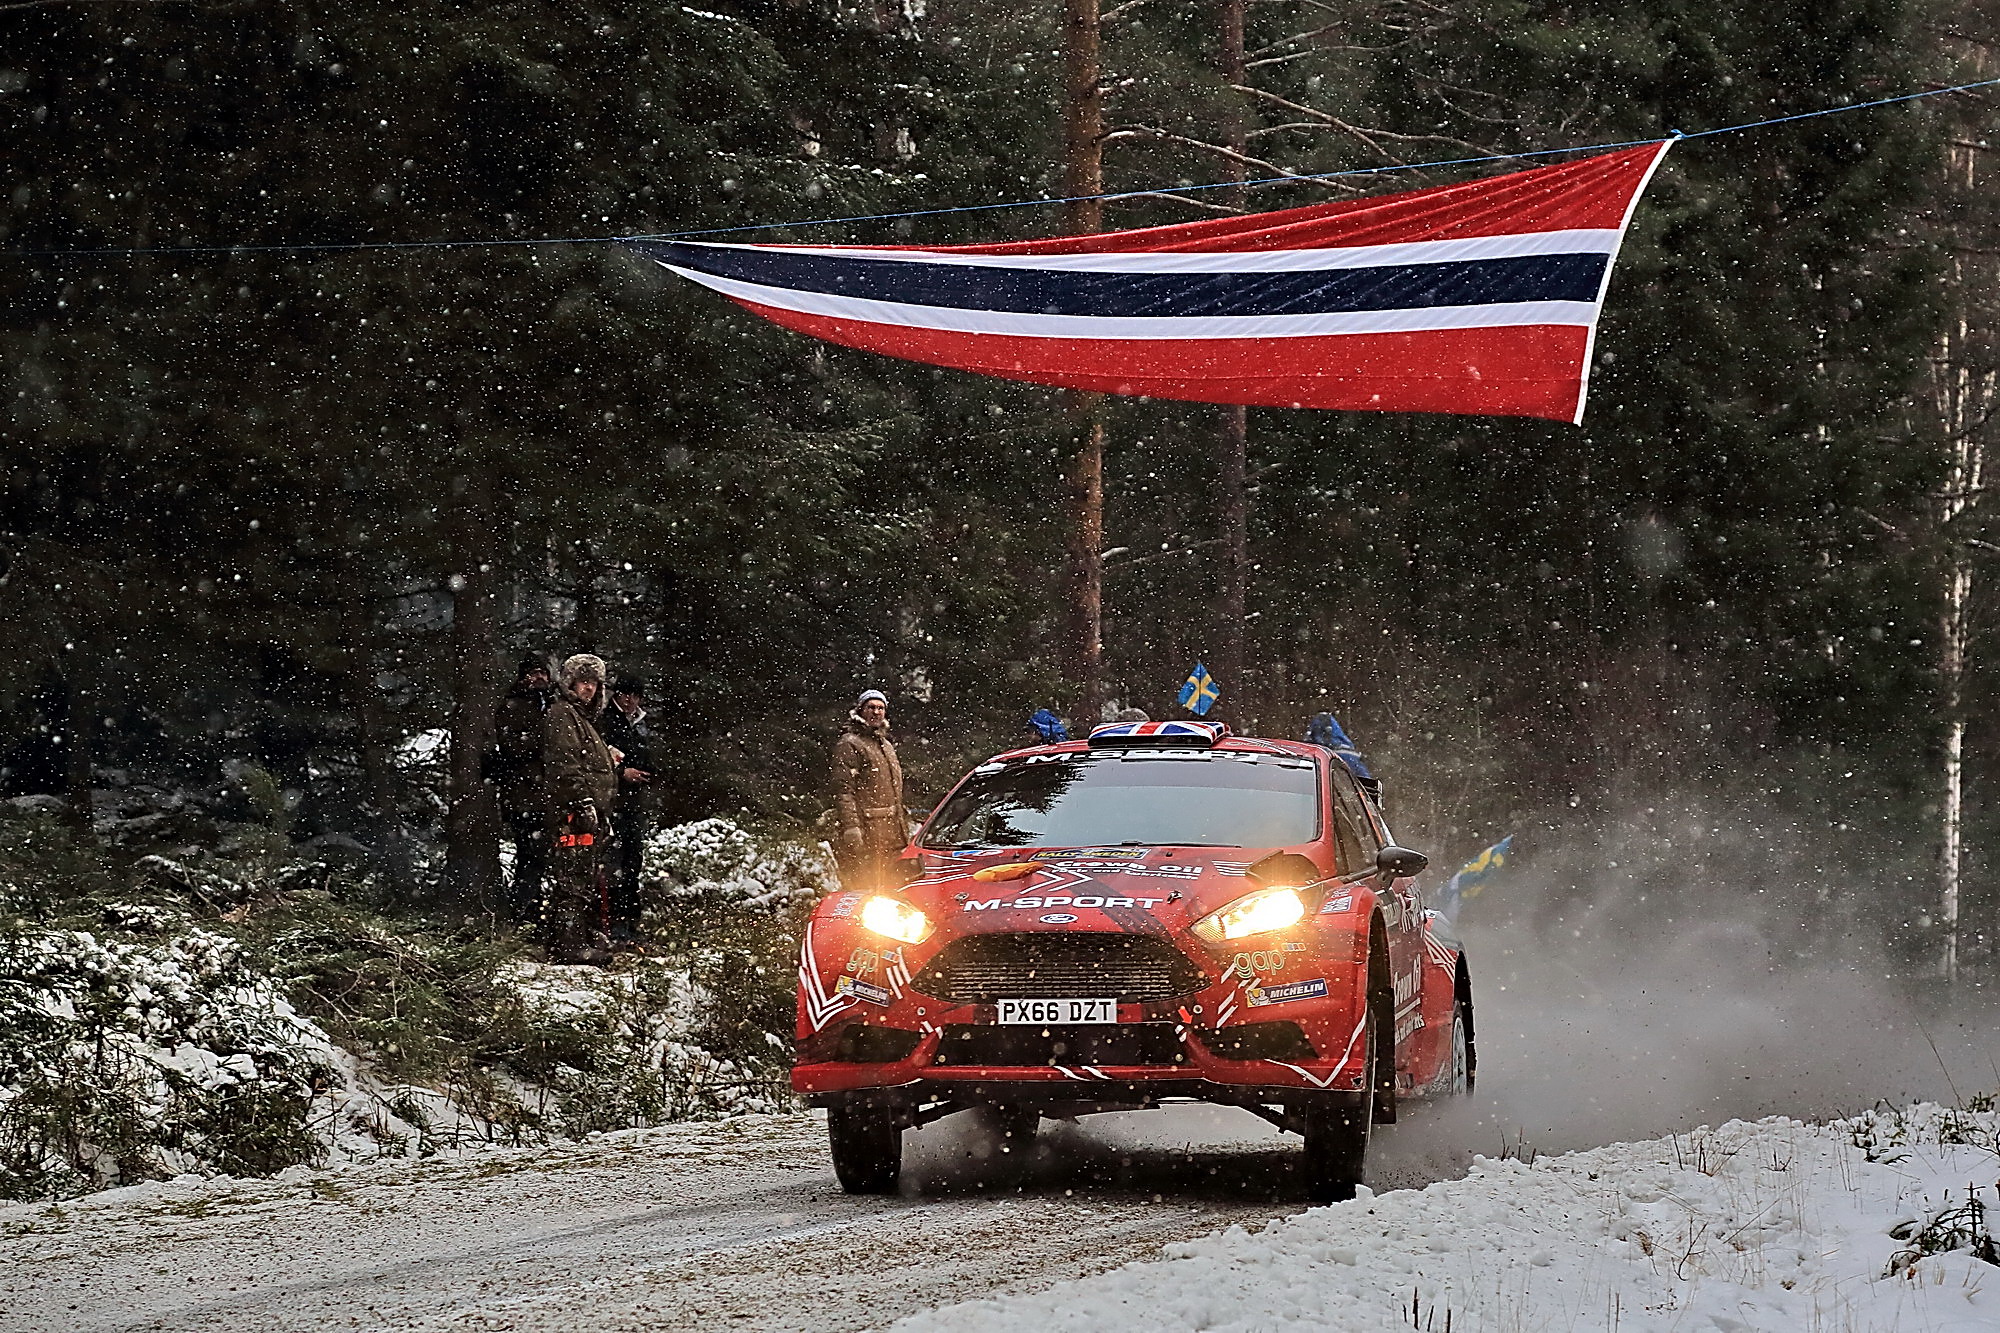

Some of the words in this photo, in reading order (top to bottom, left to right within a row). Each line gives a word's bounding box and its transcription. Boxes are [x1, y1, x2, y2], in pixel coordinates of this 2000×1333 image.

[1055, 861, 1147, 870] Crown
[1159, 865, 1203, 874] Oil
[963, 896, 1164, 912] M-SPORT
[1234, 949, 1285, 979] gap
[1270, 982, 1324, 999] MICHELIN
[1003, 1001, 1059, 1021] PX66
[1069, 1001, 1111, 1021] DZT
